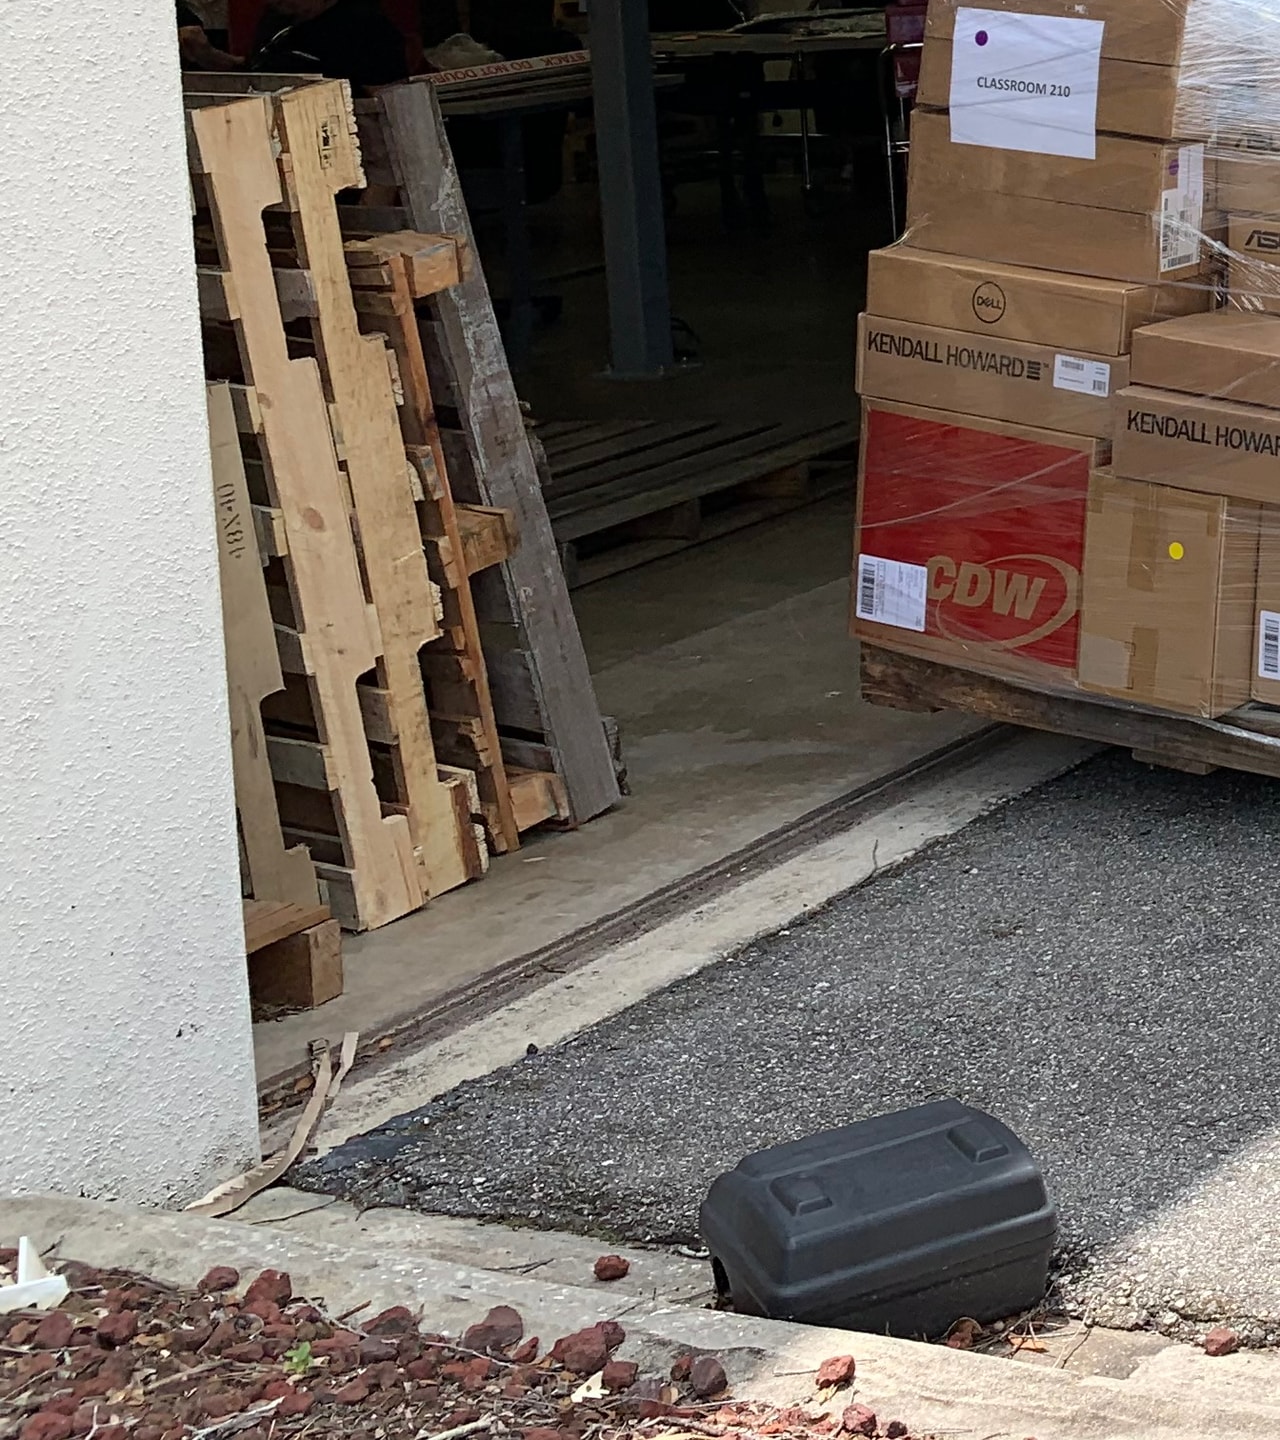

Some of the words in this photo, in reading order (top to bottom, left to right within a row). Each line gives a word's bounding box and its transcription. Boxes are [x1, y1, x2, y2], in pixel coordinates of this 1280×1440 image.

[481, 65, 506, 77] NOT
[511, 60, 533, 70] DO
[976, 76, 1047, 95] CLASSROOM
[1050, 84, 1071, 98] 210
[976, 295, 1003, 310] DELL
[867, 330, 943, 364] KENDALL
[945, 346, 1026, 378] HOWARD
[1126, 409, 1212, 445] KENDALL
[926, 555, 1047, 620] CDW
